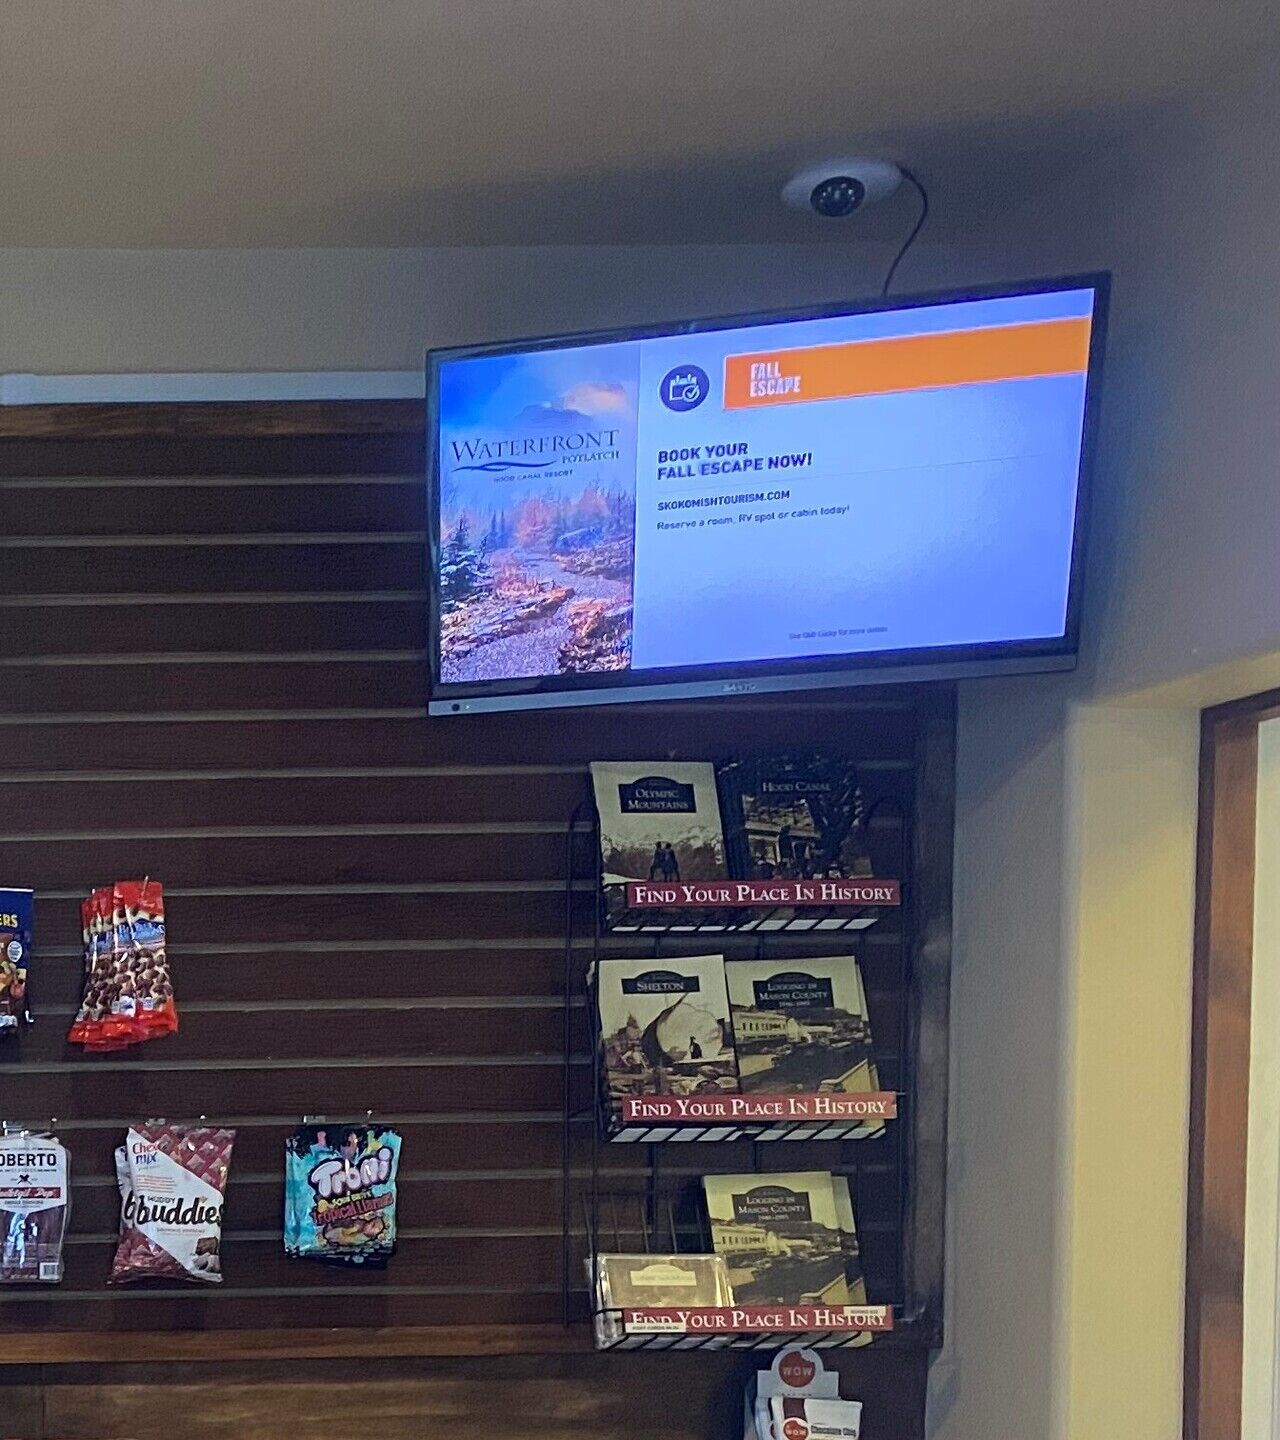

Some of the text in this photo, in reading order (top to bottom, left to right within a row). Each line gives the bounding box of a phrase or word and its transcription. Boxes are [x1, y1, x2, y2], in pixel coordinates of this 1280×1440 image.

[751, 362, 781, 379] FALL
[750, 376, 801, 397] ESCAPE
[449, 429, 620, 463] WATERFRONT
[658, 443, 748, 463] BOOK YOUR
[657, 453, 813, 480] FALL ESCAPE NOW!
[657, 490, 790, 511] SKOKOMISHTOURISM.COM
[657, 520, 696, 530] Reserve
[739, 513, 752, 523] RV
[755, 512, 775, 523] spot
[791, 508, 818, 518] cabin
[796, 781, 831, 792] CANAL
[635, 883, 894, 903] FIND YOUR PLACE IN HISTORY
[636, 981, 684, 992] SHELTON
[630, 1097, 887, 1117] FIND YOUR PLACE IN HISTORY
[678, 1310, 726, 1328] YOUR
[731, 1310, 783, 1327] PLACE
[789, 1309, 808, 1325] IN
[783, 1366, 814, 1376] WOW
